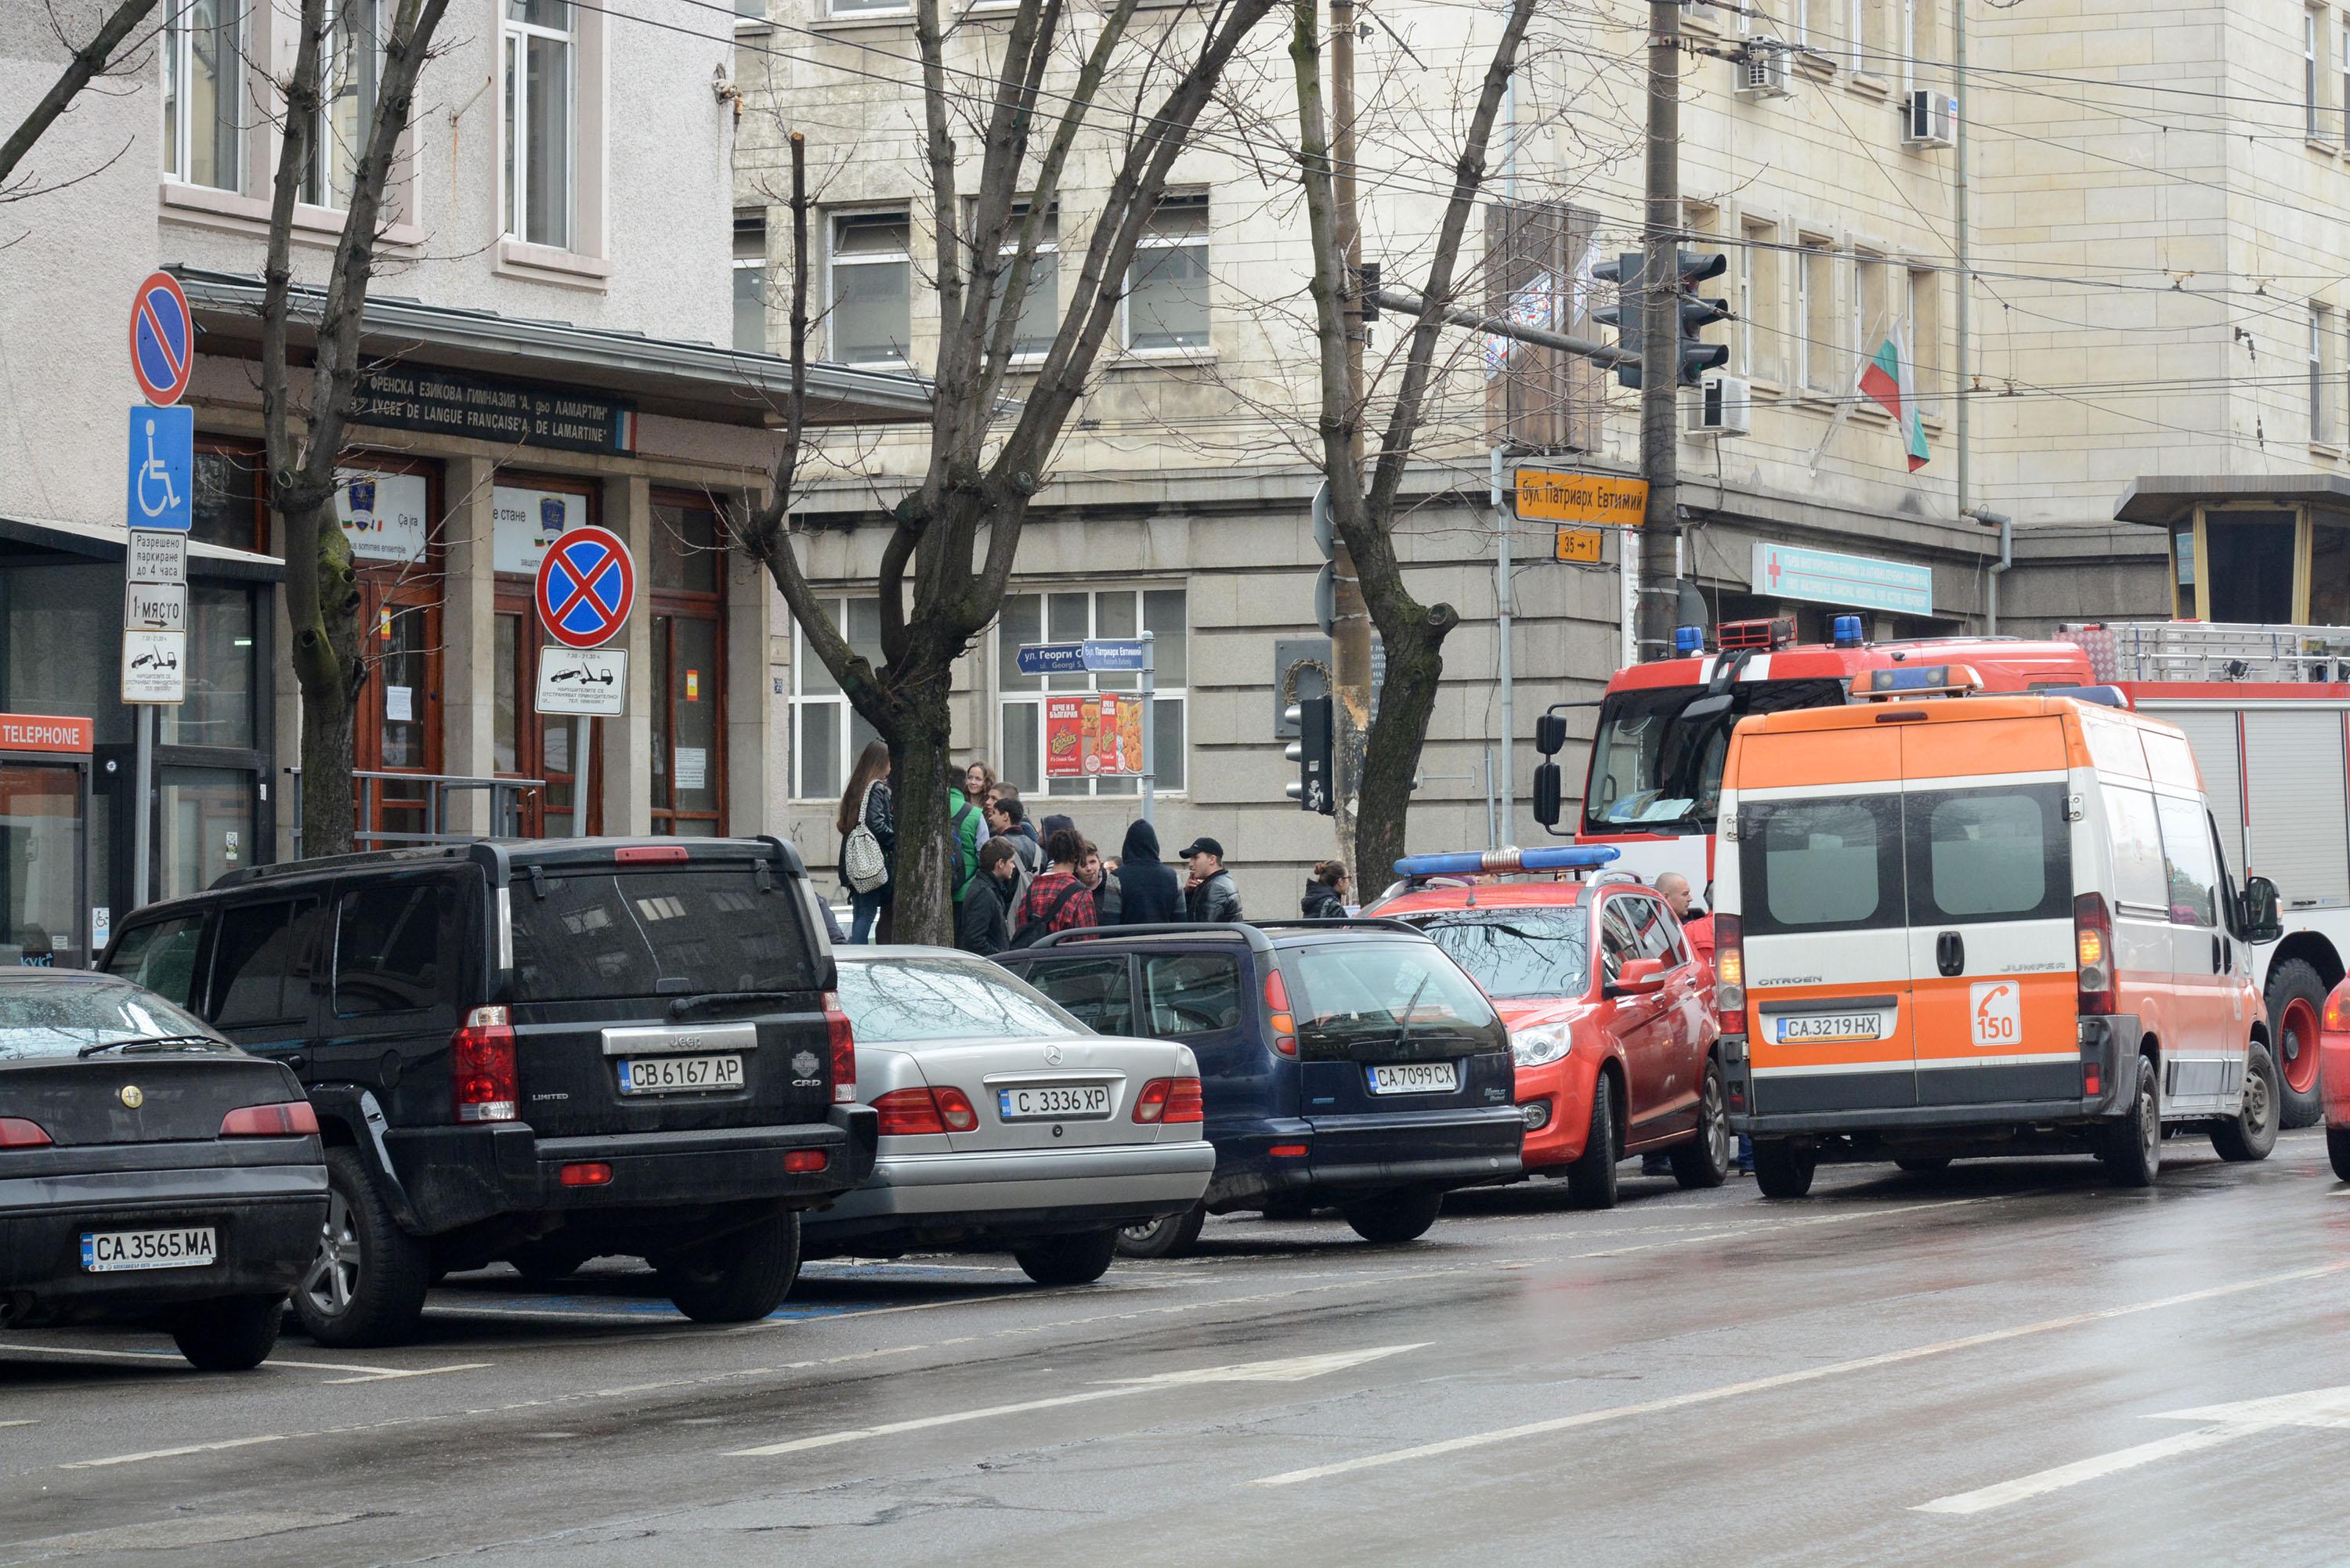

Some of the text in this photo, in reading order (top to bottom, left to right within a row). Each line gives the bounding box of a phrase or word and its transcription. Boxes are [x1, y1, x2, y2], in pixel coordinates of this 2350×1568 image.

[371, 376, 414, 396] ФРЕНСКА
[419, 381, 462, 402] ЕЗИКОВА
[467, 388, 515, 408] ГИМНАЗИЯ
[555, 400, 608, 421] ЛАМАРТИН"
[407, 403, 419, 419] DE
[425, 405, 462, 425] LANGUE
[536, 420, 548, 435] DE
[552, 422, 607, 443] LAMARTINE"
[1523, 480, 1643, 511] бул. Патриарх Евтимий
[398, 513, 408, 528] Ça
[501, 509, 526, 522] стане
[136, 535, 179, 550] Разрешено
[358, 543, 380, 551] sommes
[381, 544, 406, 554] ensemble
[1564, 536, 1593, 555] 35 1
[136, 552, 178, 564] паркиране
[137, 564, 178, 576] до 4 часа
[142, 602, 179, 619] МЯСТО
[1025, 652, 1036, 662] ул.
[1039, 650, 1072, 661] Георги
[1095, 646, 1119, 657] Патриарх
[1119, 646, 1141, 656] Евтимий
[1052, 661, 1075, 670] Georgi
[2, 725, 80, 745] TELEPHONE
[1051, 734, 1078, 753] Texas
[2000, 963, 2066, 972] JUMPER
[1788, 1021, 1809, 1037] CA
[1813, 1018, 1852, 1035] 3219
[1855, 1017, 1876, 1033] HX
[1977, 1017, 2012, 1039] 150
[670, 1035, 702, 1050] Jeep
[621, 1060, 739, 1087] BG CB 6167 AP
[1378, 1068, 1398, 1086] CA
[1398, 1067, 1432, 1086] 7099
[1435, 1065, 1453, 1083] CX
[1018, 1093, 1030, 1112] C
[1039, 1091, 1081, 1111] 3336
[1083, 1089, 1105, 1110] XP
[97, 1237, 126, 1261] CA
[132, 1234, 181, 1259] 3565
[186, 1231, 212, 1255] MA
